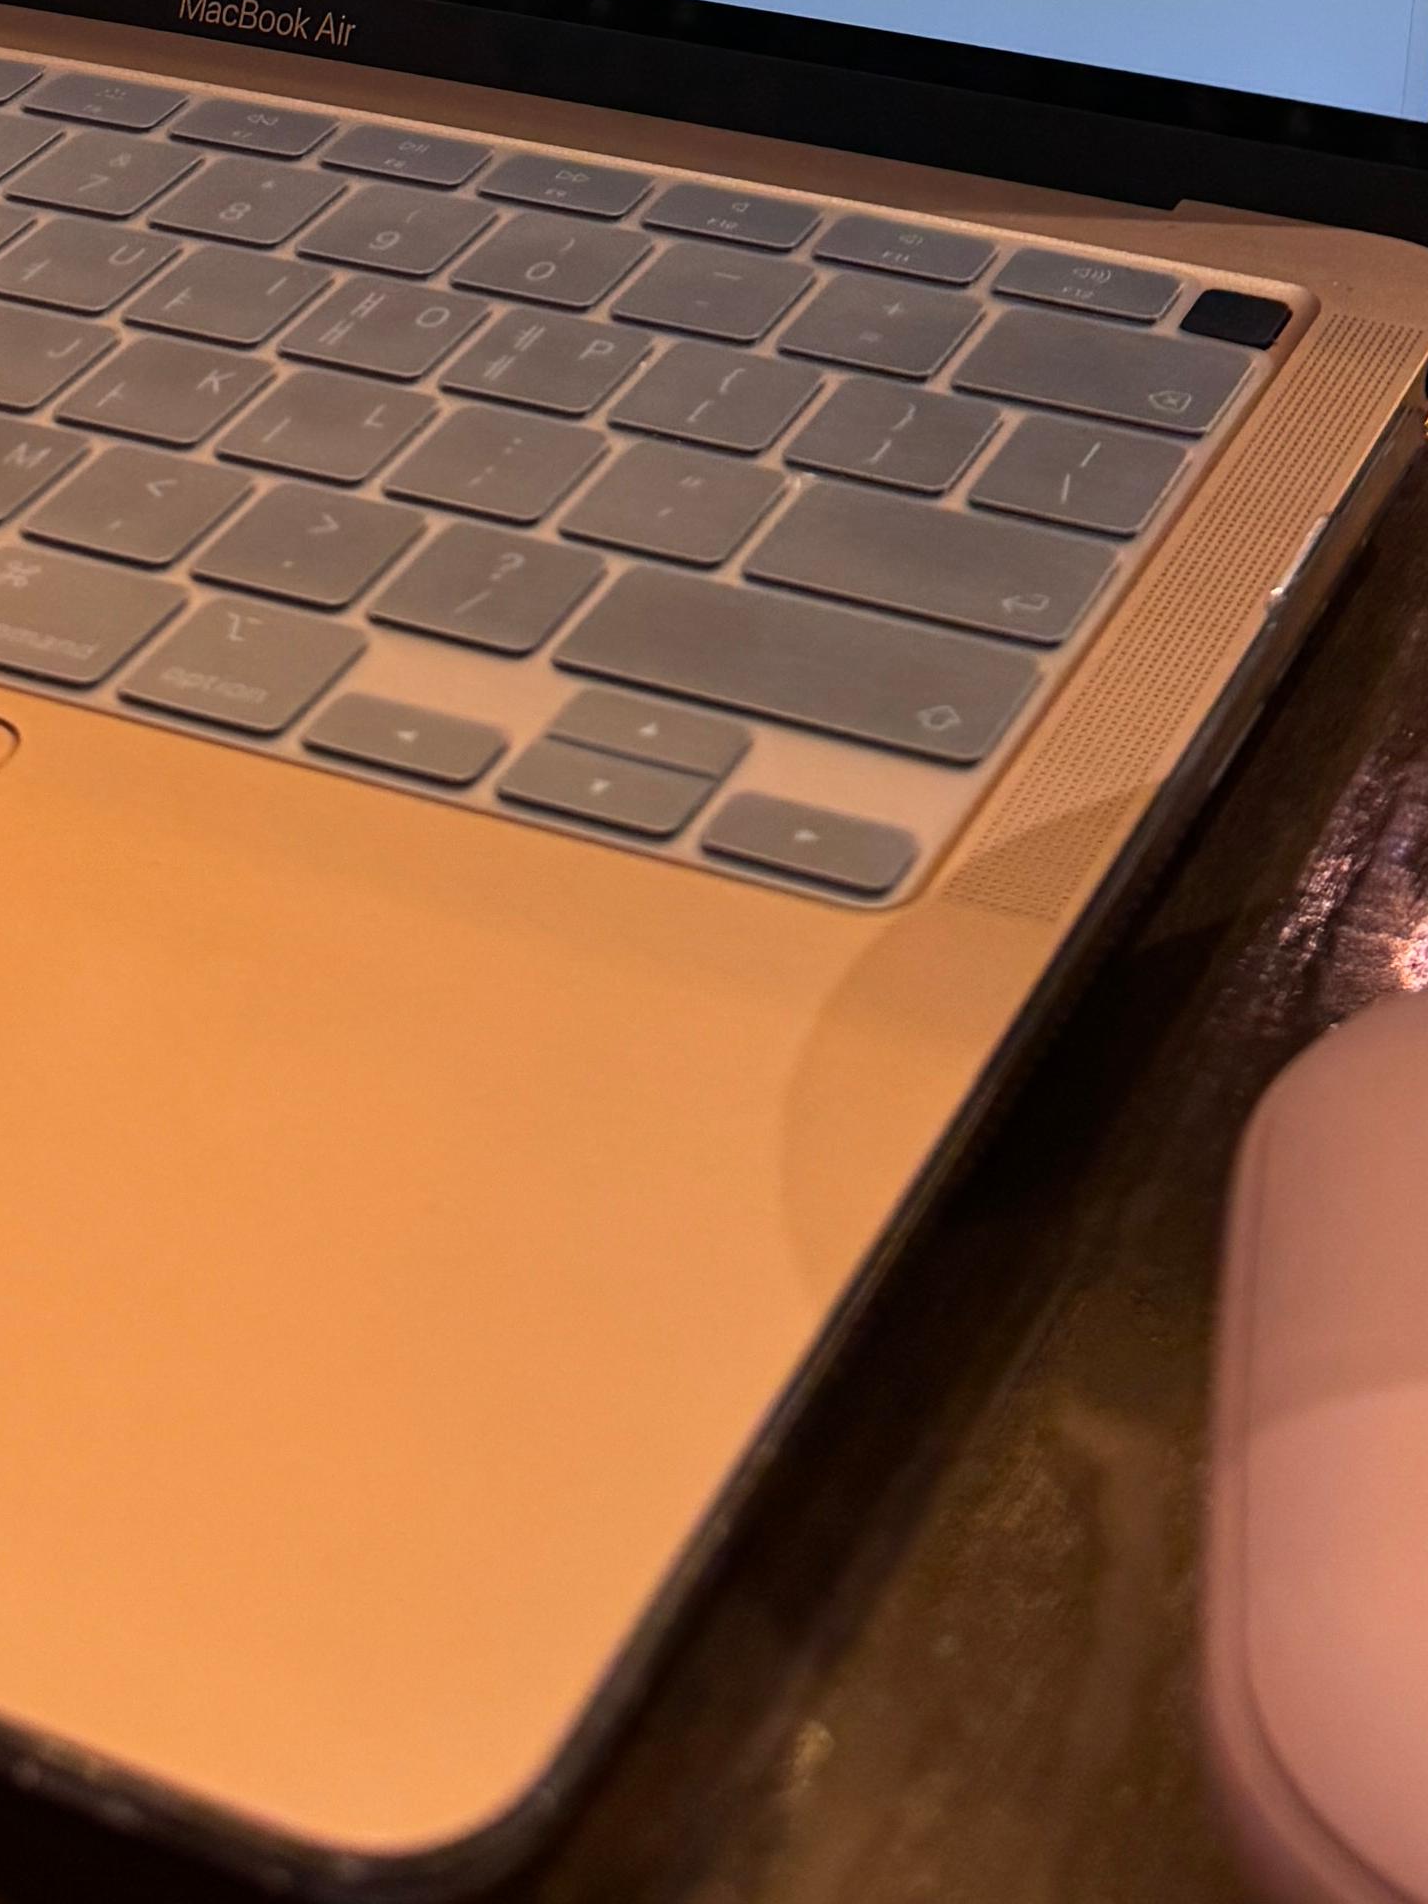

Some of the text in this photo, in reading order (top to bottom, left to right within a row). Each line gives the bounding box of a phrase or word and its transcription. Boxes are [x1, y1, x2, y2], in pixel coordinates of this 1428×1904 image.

[314, 11, 358, 48] Air
[78, 174, 110, 192] 7
[218, 201, 253, 221] 8
[368, 230, 401, 252] 9
[108, 244, 146, 266] U
[47, 337, 83, 359] J
[580, 339, 615, 363] P
[196, 369, 238, 395] K
[362, 403, 386, 429] L
[2, 441, 52, 470] M
